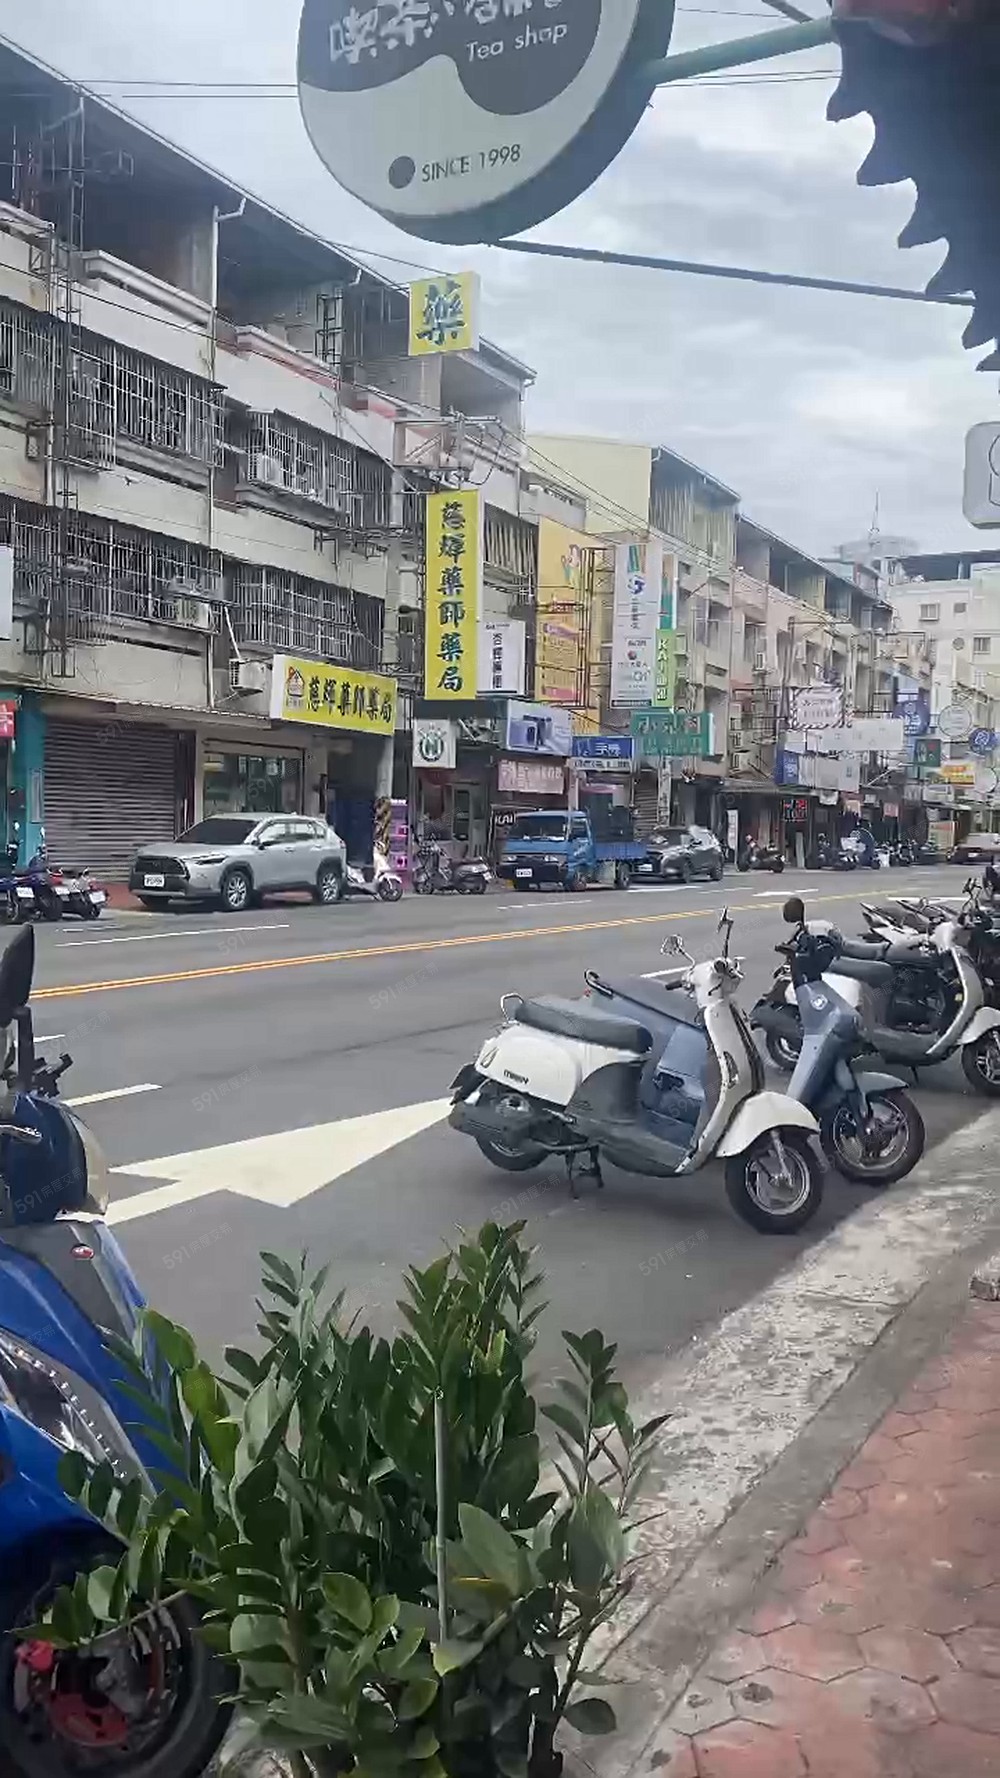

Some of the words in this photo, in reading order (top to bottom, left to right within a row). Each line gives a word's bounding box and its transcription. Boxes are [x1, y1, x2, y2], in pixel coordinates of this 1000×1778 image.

[467, 40, 504, 61] Tea
[515, 24, 568, 49] shop
[422, 157, 470, 182] SINCE
[480, 144, 521, 169] 1998
[416, 280, 466, 346] 藥
